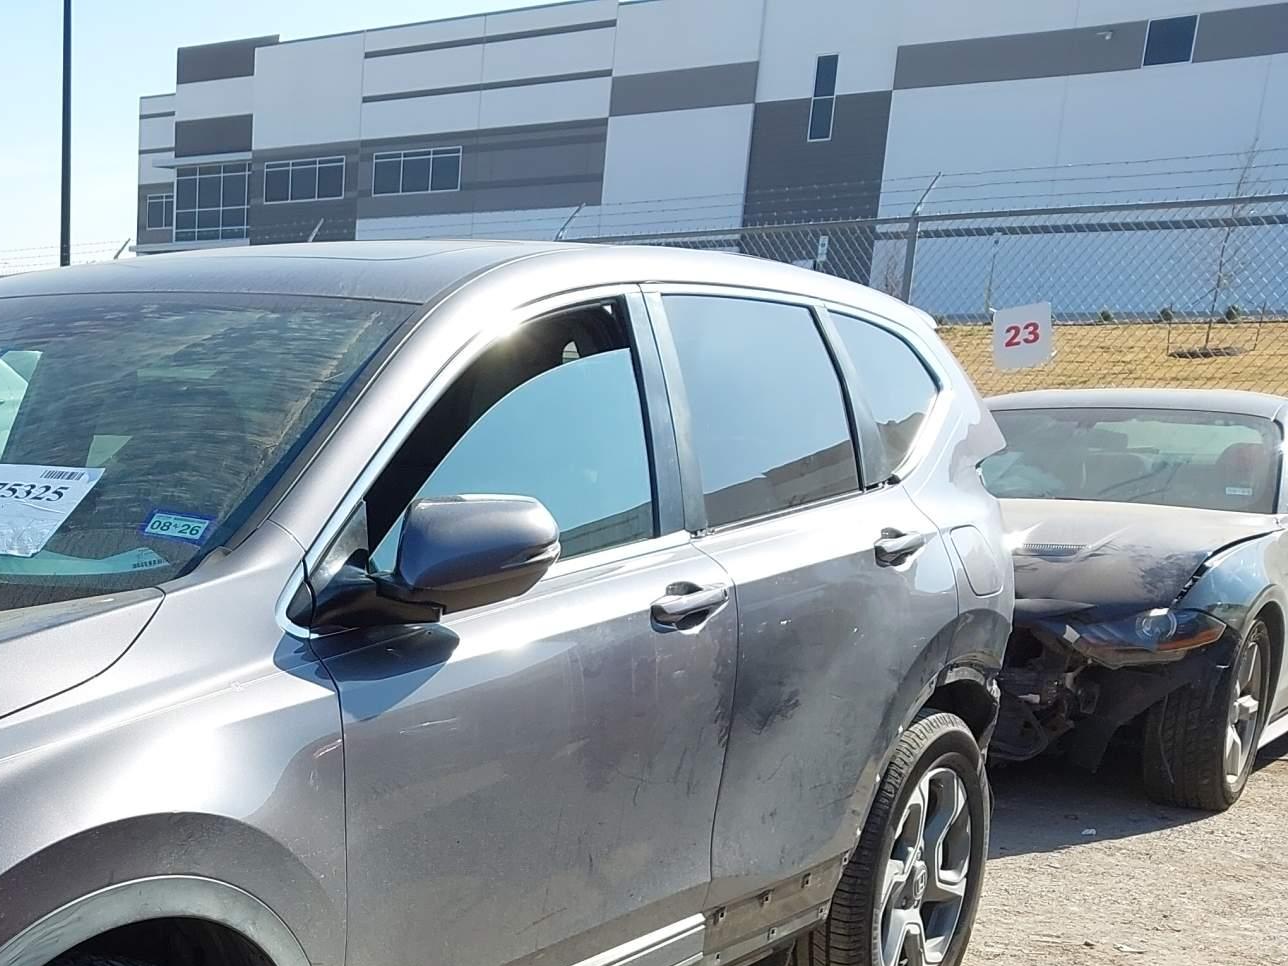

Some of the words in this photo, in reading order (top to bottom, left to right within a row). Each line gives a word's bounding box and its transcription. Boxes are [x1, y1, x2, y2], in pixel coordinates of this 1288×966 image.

[1004, 321, 1041, 348] 23
[150, 520, 172, 532] 08
[178, 523, 202, 536] 26
